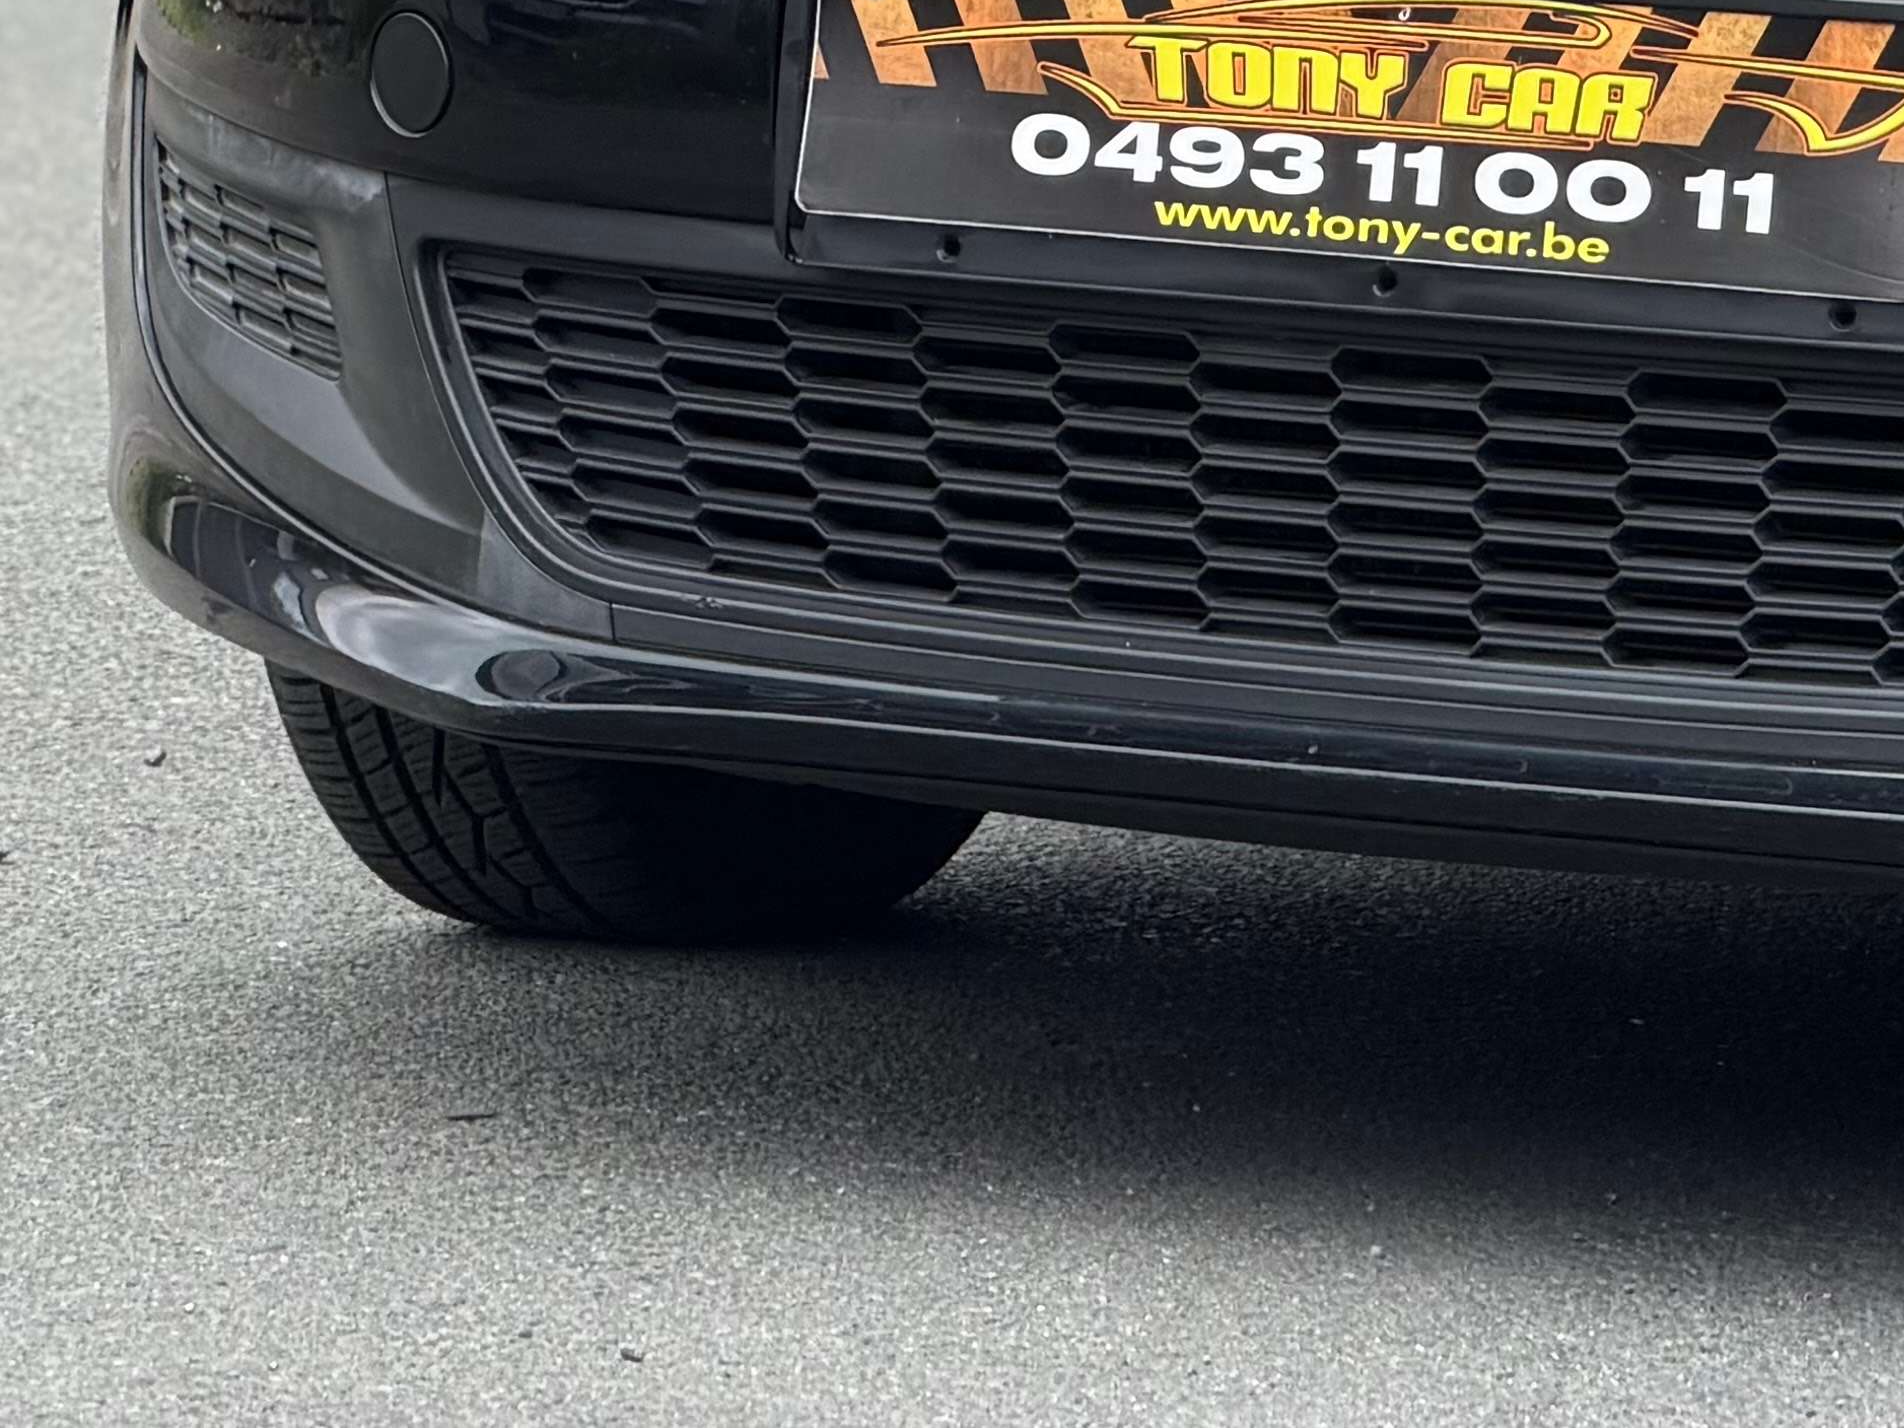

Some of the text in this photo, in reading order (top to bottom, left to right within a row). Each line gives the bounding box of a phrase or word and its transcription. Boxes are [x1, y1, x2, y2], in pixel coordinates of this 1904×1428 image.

[1126, 35, 1656, 141] TONY CAR
[1010, 112, 1775, 235] 0493 11 00 11
[1153, 199, 1611, 264] www.tony-car.be
